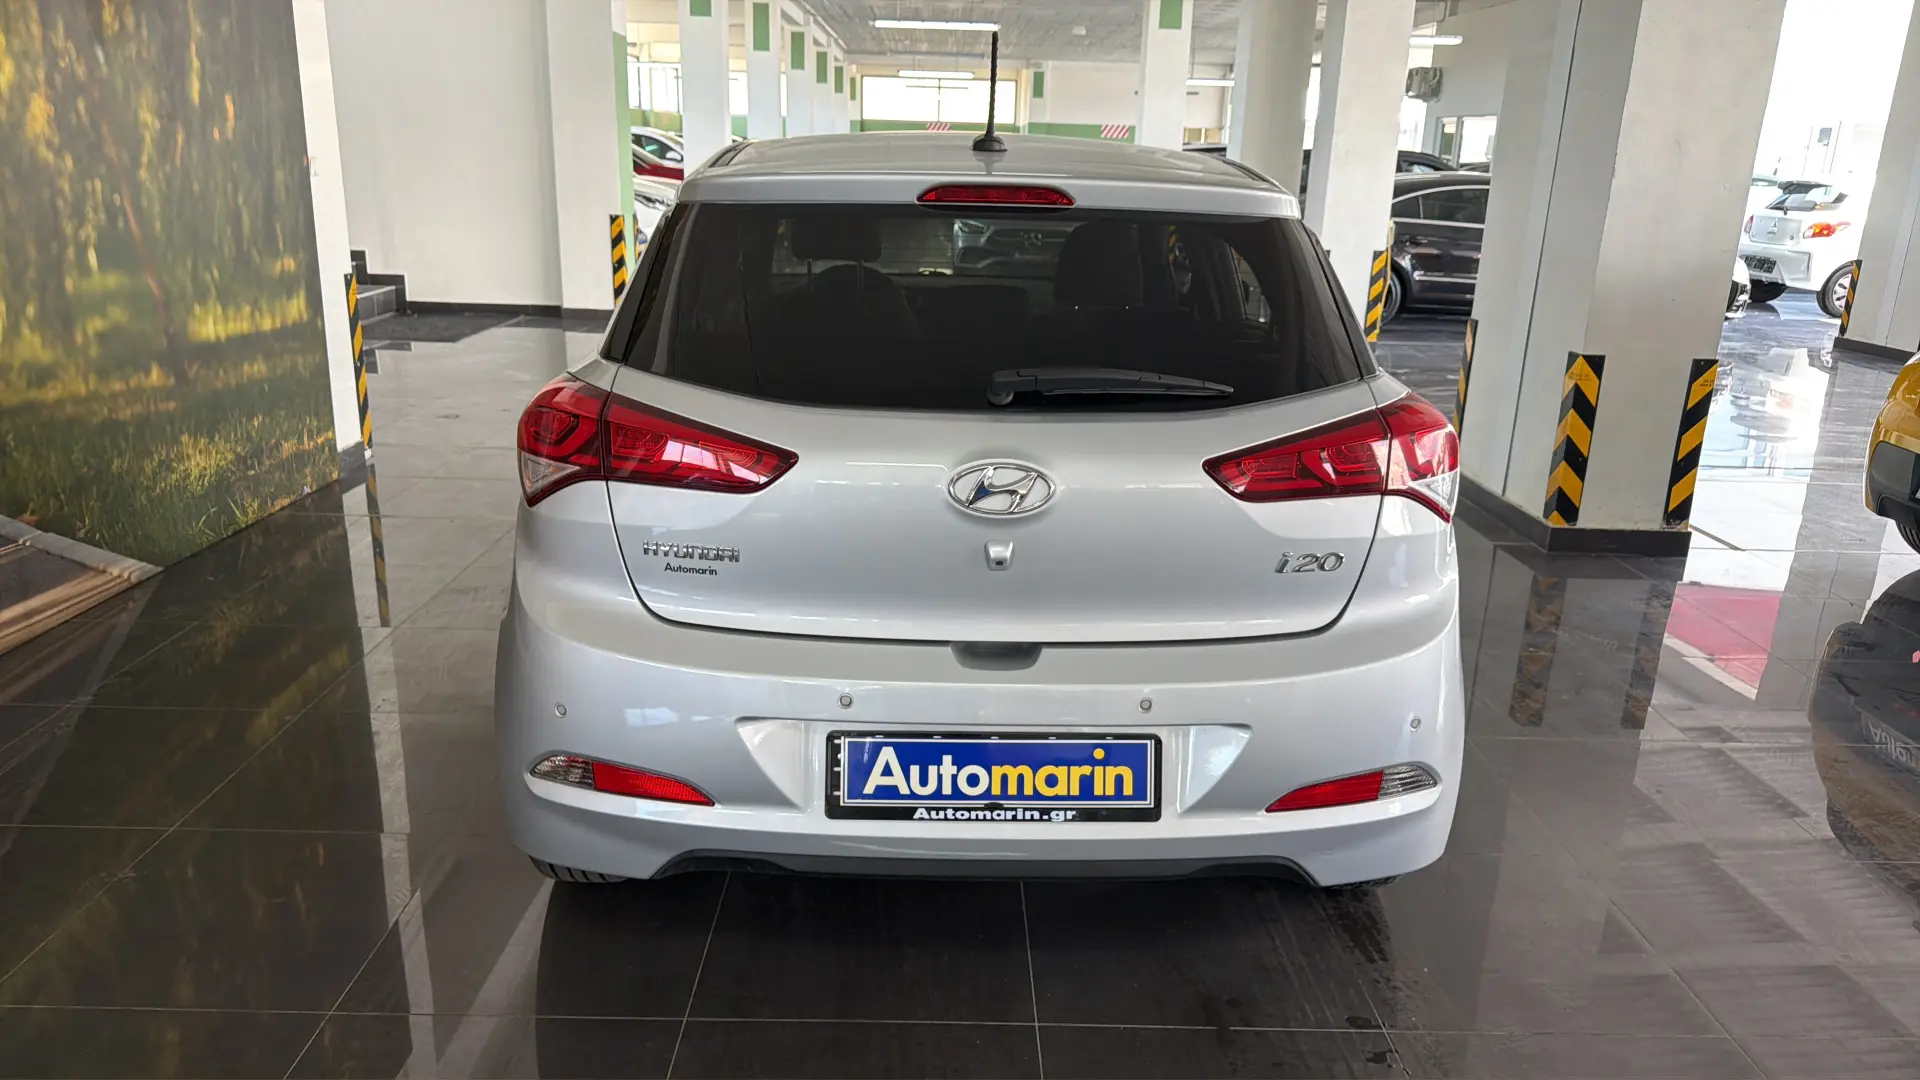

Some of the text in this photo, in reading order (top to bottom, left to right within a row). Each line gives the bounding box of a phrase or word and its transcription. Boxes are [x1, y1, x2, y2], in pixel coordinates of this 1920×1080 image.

[643, 540, 740, 562] HYUNDAI
[664, 562, 718, 576] Automarin
[1275, 552, 1345, 573] i20
[863, 746, 1133, 796] Automarin
[913, 807, 1076, 821] Automarin.gr
